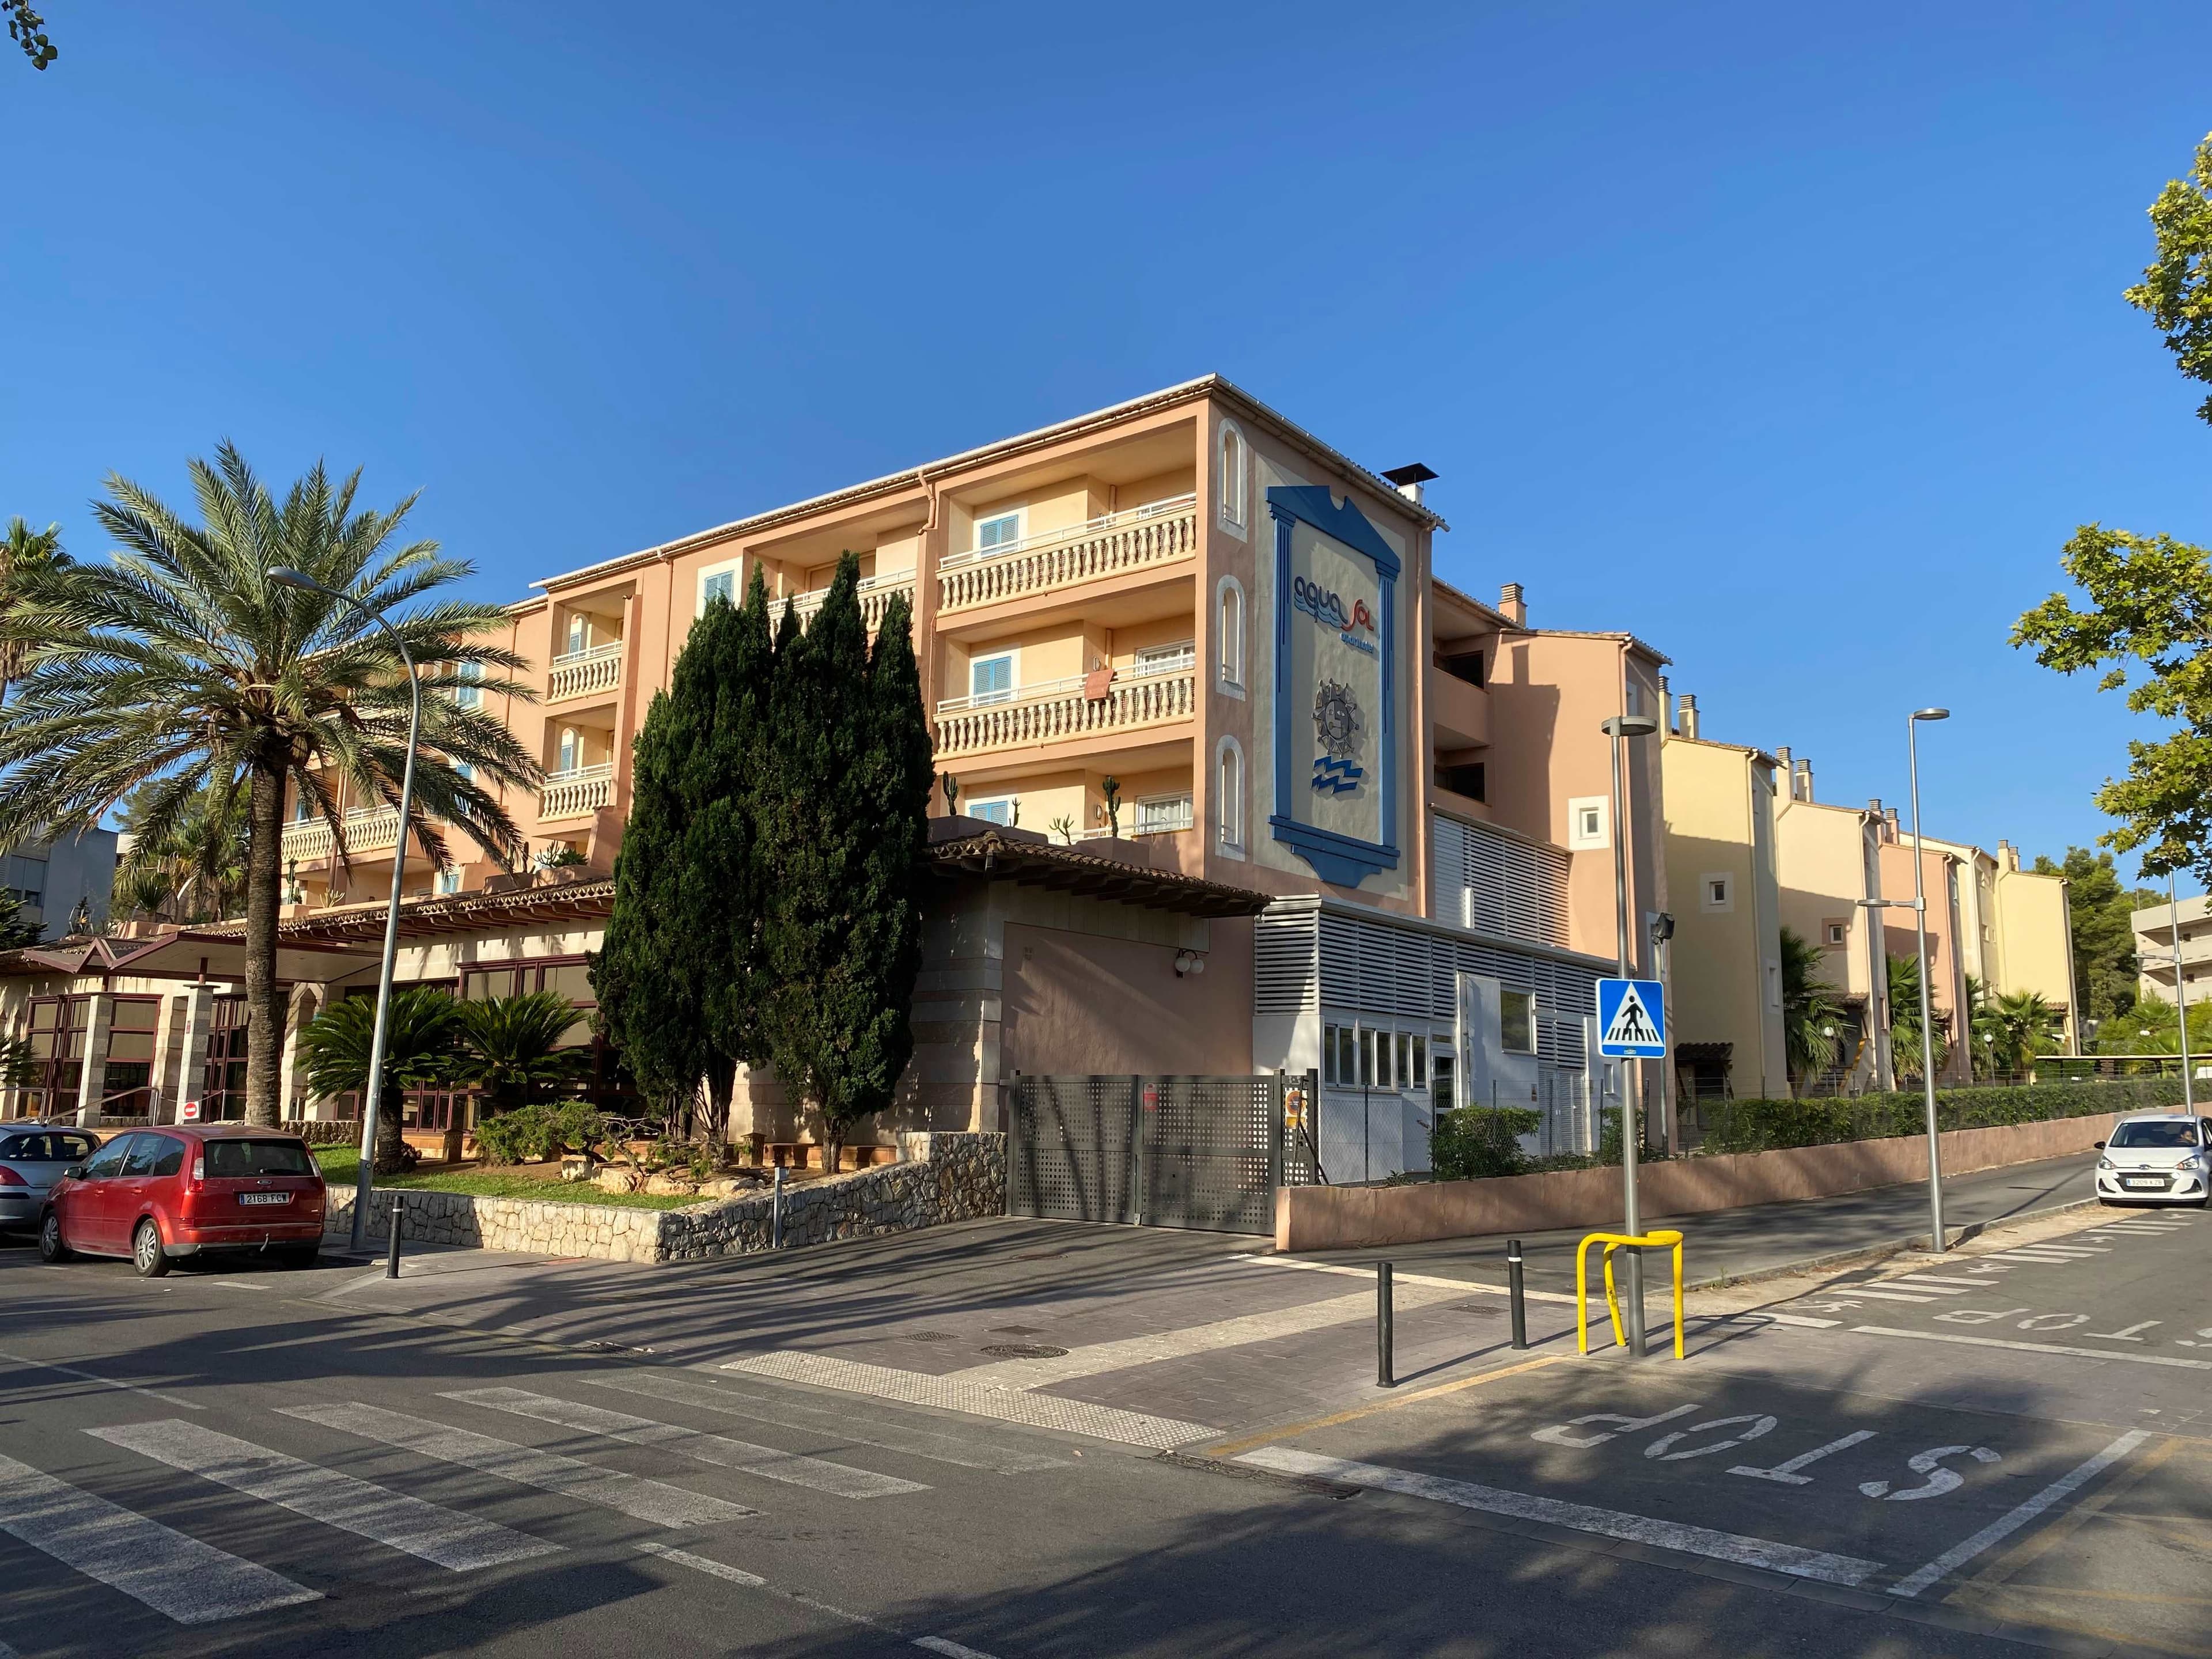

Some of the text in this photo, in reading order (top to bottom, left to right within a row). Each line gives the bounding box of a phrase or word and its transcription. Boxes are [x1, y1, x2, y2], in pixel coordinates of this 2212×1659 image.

[1294, 576, 1348, 623] aqua
[247, 1193, 286, 1203] 2168 FCW
[1530, 1403, 2002, 1501] STOP
